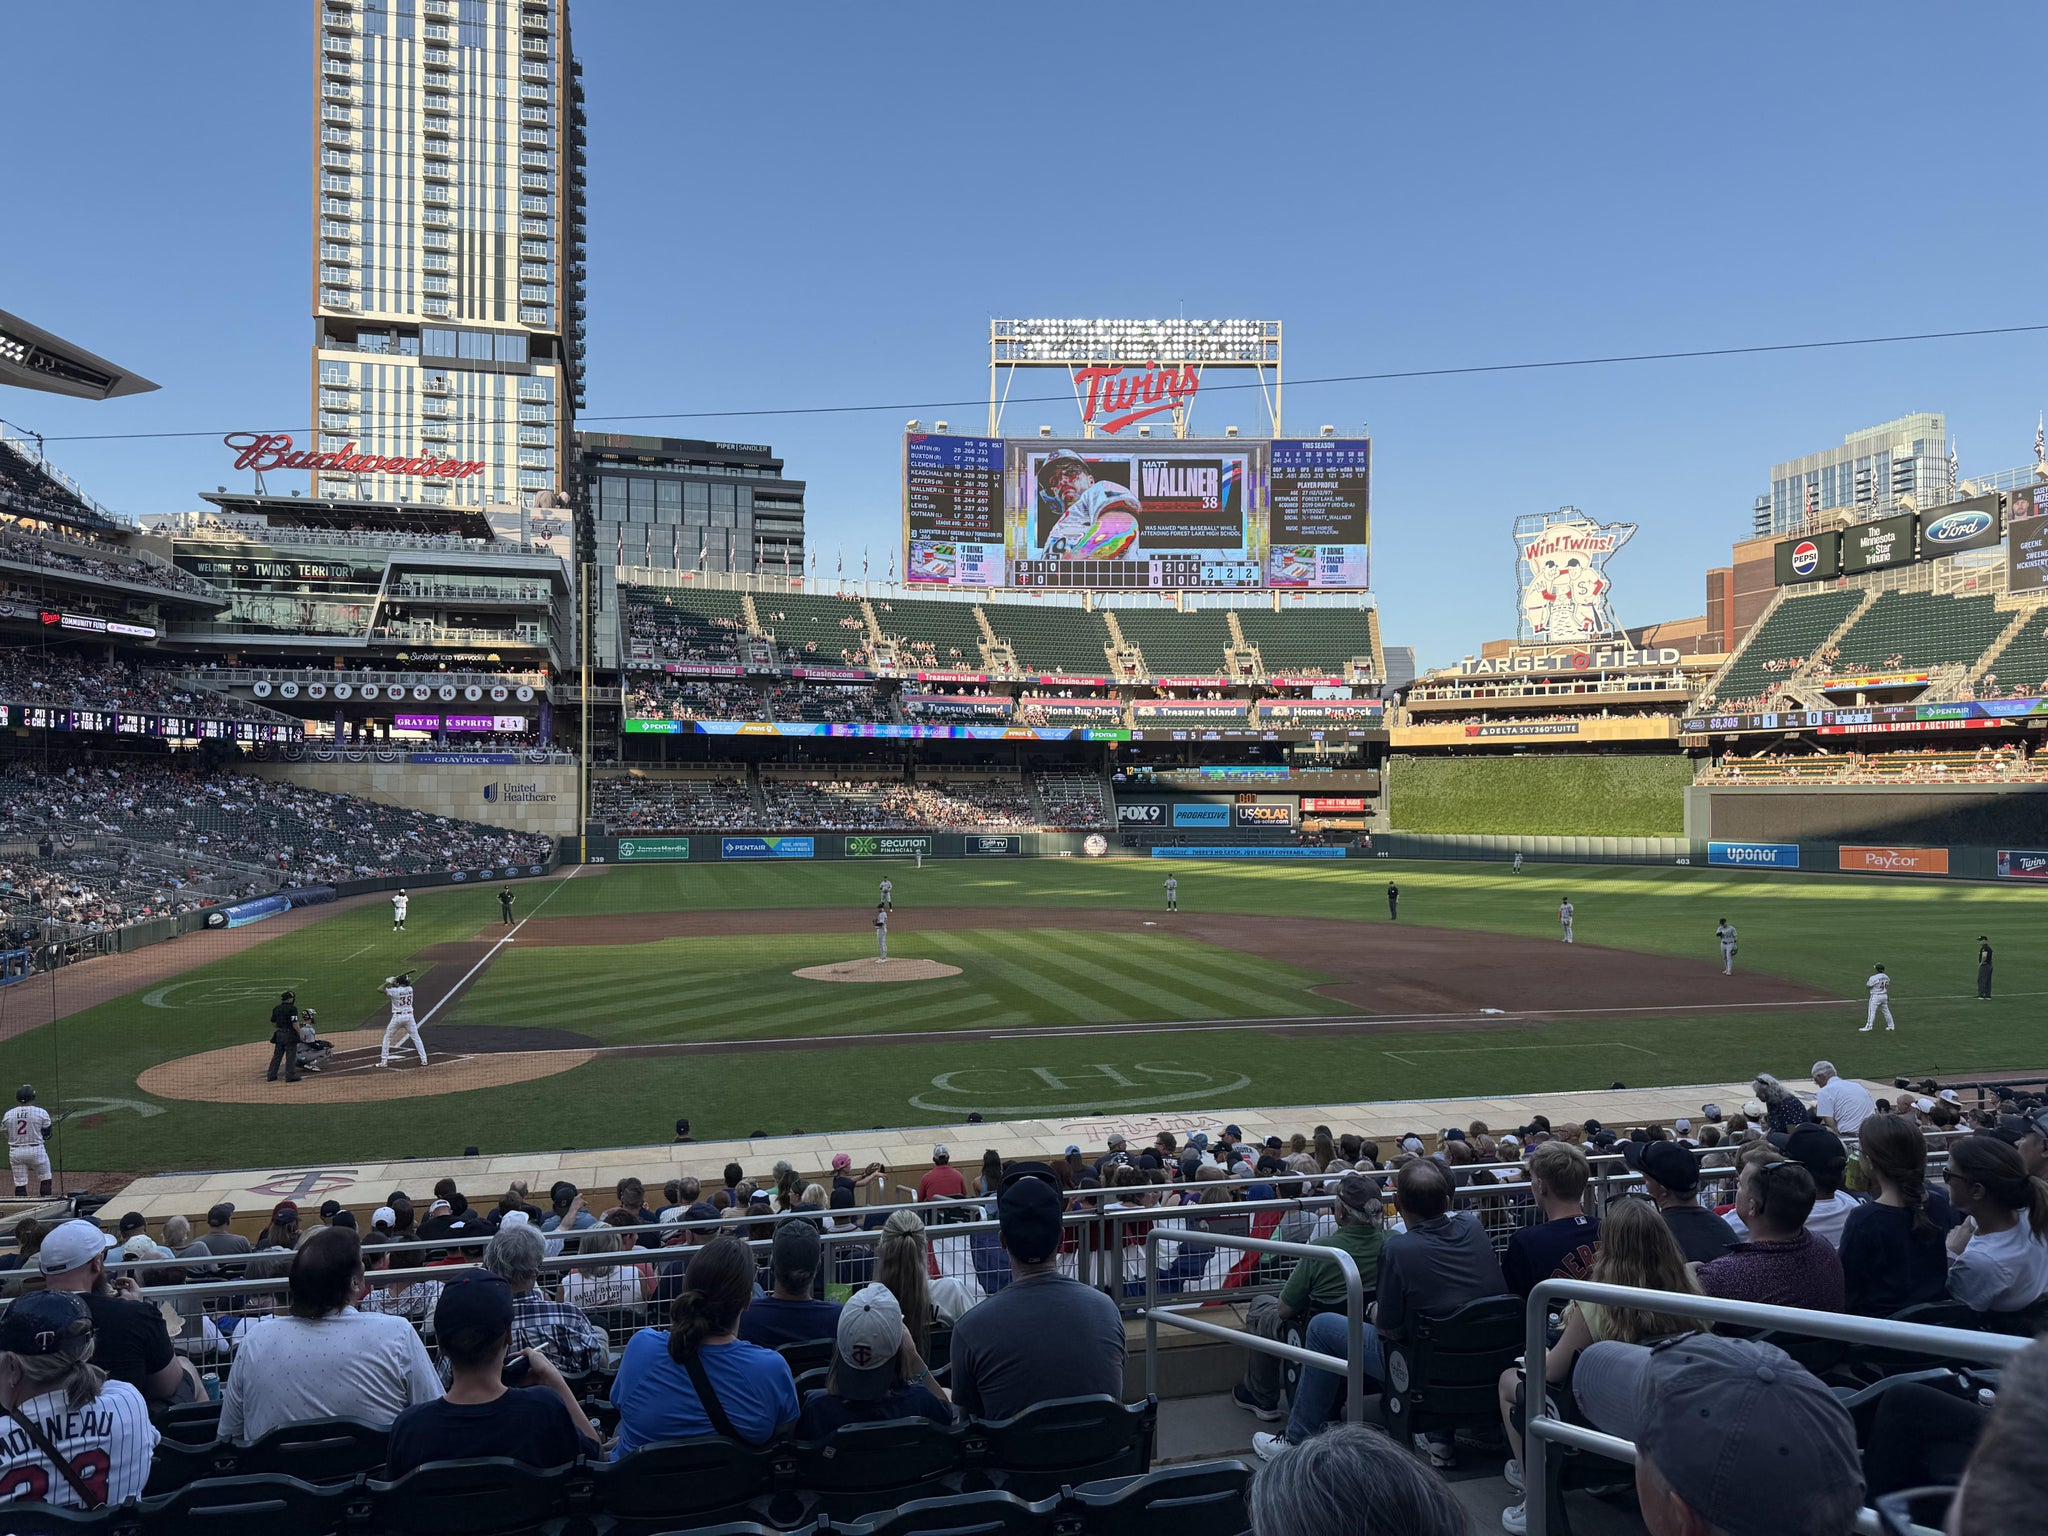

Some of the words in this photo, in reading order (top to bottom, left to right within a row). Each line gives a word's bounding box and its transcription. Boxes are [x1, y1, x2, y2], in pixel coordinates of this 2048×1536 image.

[1074, 361, 1199, 424] Twins
[716, 442, 736, 450] PIPER
[738, 443, 767, 452] SANDLER
[224, 432, 485, 478] Budweiser
[1142, 468, 1218, 497] WALLNER
[1202, 497, 1218, 509] 38
[1868, 527, 1880, 536] The
[1938, 515, 1978, 538] Ford
[1860, 532, 1895, 547] Minnesota
[1526, 536, 1560, 559] Win!
[1563, 535, 1613, 551] Twins!
[1875, 543, 1891, 554] Star
[2020, 540, 2042, 550] GREENE
[1794, 553, 1816, 564] PEPSI
[1865, 552, 1890, 564] Tribune
[197, 563, 231, 573] WELCOME
[254, 563, 291, 577] TWINS
[298, 564, 356, 578] TERRITORY
[1578, 581, 1588, 595] S
[41, 612, 61, 624] Twins
[61, 616, 92, 628] COMMUNITY
[92, 621, 106, 630] FUND
[410, 652, 439, 661] Surfside
[1461, 655, 1567, 674] TARGET
[1596, 648, 1681, 668] FIELD
[674, 665, 710, 673] Treasure
[711, 666, 736, 674] Island
[925, 673, 956, 681] Treasure
[258, 685, 266, 693] W
[284, 686, 295, 694] 42
[312, 687, 322, 695] 36
[340, 687, 346, 696] 7
[365, 687, 374, 695] 10
[391, 688, 401, 696] 28
[417, 688, 427, 696] 34
[443, 688, 452, 697] 14
[471, 689, 476, 697] 6
[494, 689, 505, 697] 29
[522, 689, 527, 698] 3
[35, 708, 45, 718] PIT
[928, 704, 971, 713] Treasure
[974, 704, 1004, 714] Island
[1045, 706, 1073, 715] Home
[1075, 706, 1093, 715] Run
[1095, 706, 1118, 716] Deck
[1161, 708, 1204, 717] Treasure
[1206, 708, 1237, 717] Island
[1293, 708, 1322, 716] Home
[1325, 708, 1345, 716] Run
[1346, 708, 1372, 716] Deck
[1936, 707, 1969, 715] PENTAIR
[82, 712, 93, 721] TEX
[127, 715, 137, 724] PHI
[32, 718, 46, 727] CHC
[81, 721, 94, 730] TOR
[96, 721, 103, 730] 14
[168, 718, 179, 727] SEA
[207, 720, 217, 729] MIA
[397, 719, 424, 727] GRAY
[426, 719, 453, 727] DUK
[455, 719, 492, 727] SPIRITS
[1710, 717, 1738, 729] $6,305
[1845, 724, 1887, 733] UNIVERSAL
[1890, 722, 1920, 731] SPORTS
[1925, 720, 1966, 730] AUCTIONS
[125, 724, 138, 733] WAS
[206, 729, 217, 737] BOS
[862, 727, 898, 735] sustainable
[1490, 727, 1517, 735] DELTA
[1552, 725, 1576, 733] SUITE
[503, 783, 536, 793] United
[503, 792, 556, 803] Healthcare
[1118, 807, 1150, 820] FOX
[1151, 807, 1160, 820] 9
[880, 839, 926, 847] securian
[636, 845, 686, 853] JamesHardie
[1727, 848, 1777, 862] uponor
[1865, 853, 1919, 868] Paycor
[2020, 857, 2046, 869] Twins
[400, 995, 412, 1006] 38
[931, 1061, 1212, 1095] CHS
[17, 1119, 27, 1135] 2
[1062, 1116, 1223, 1143] Twins
